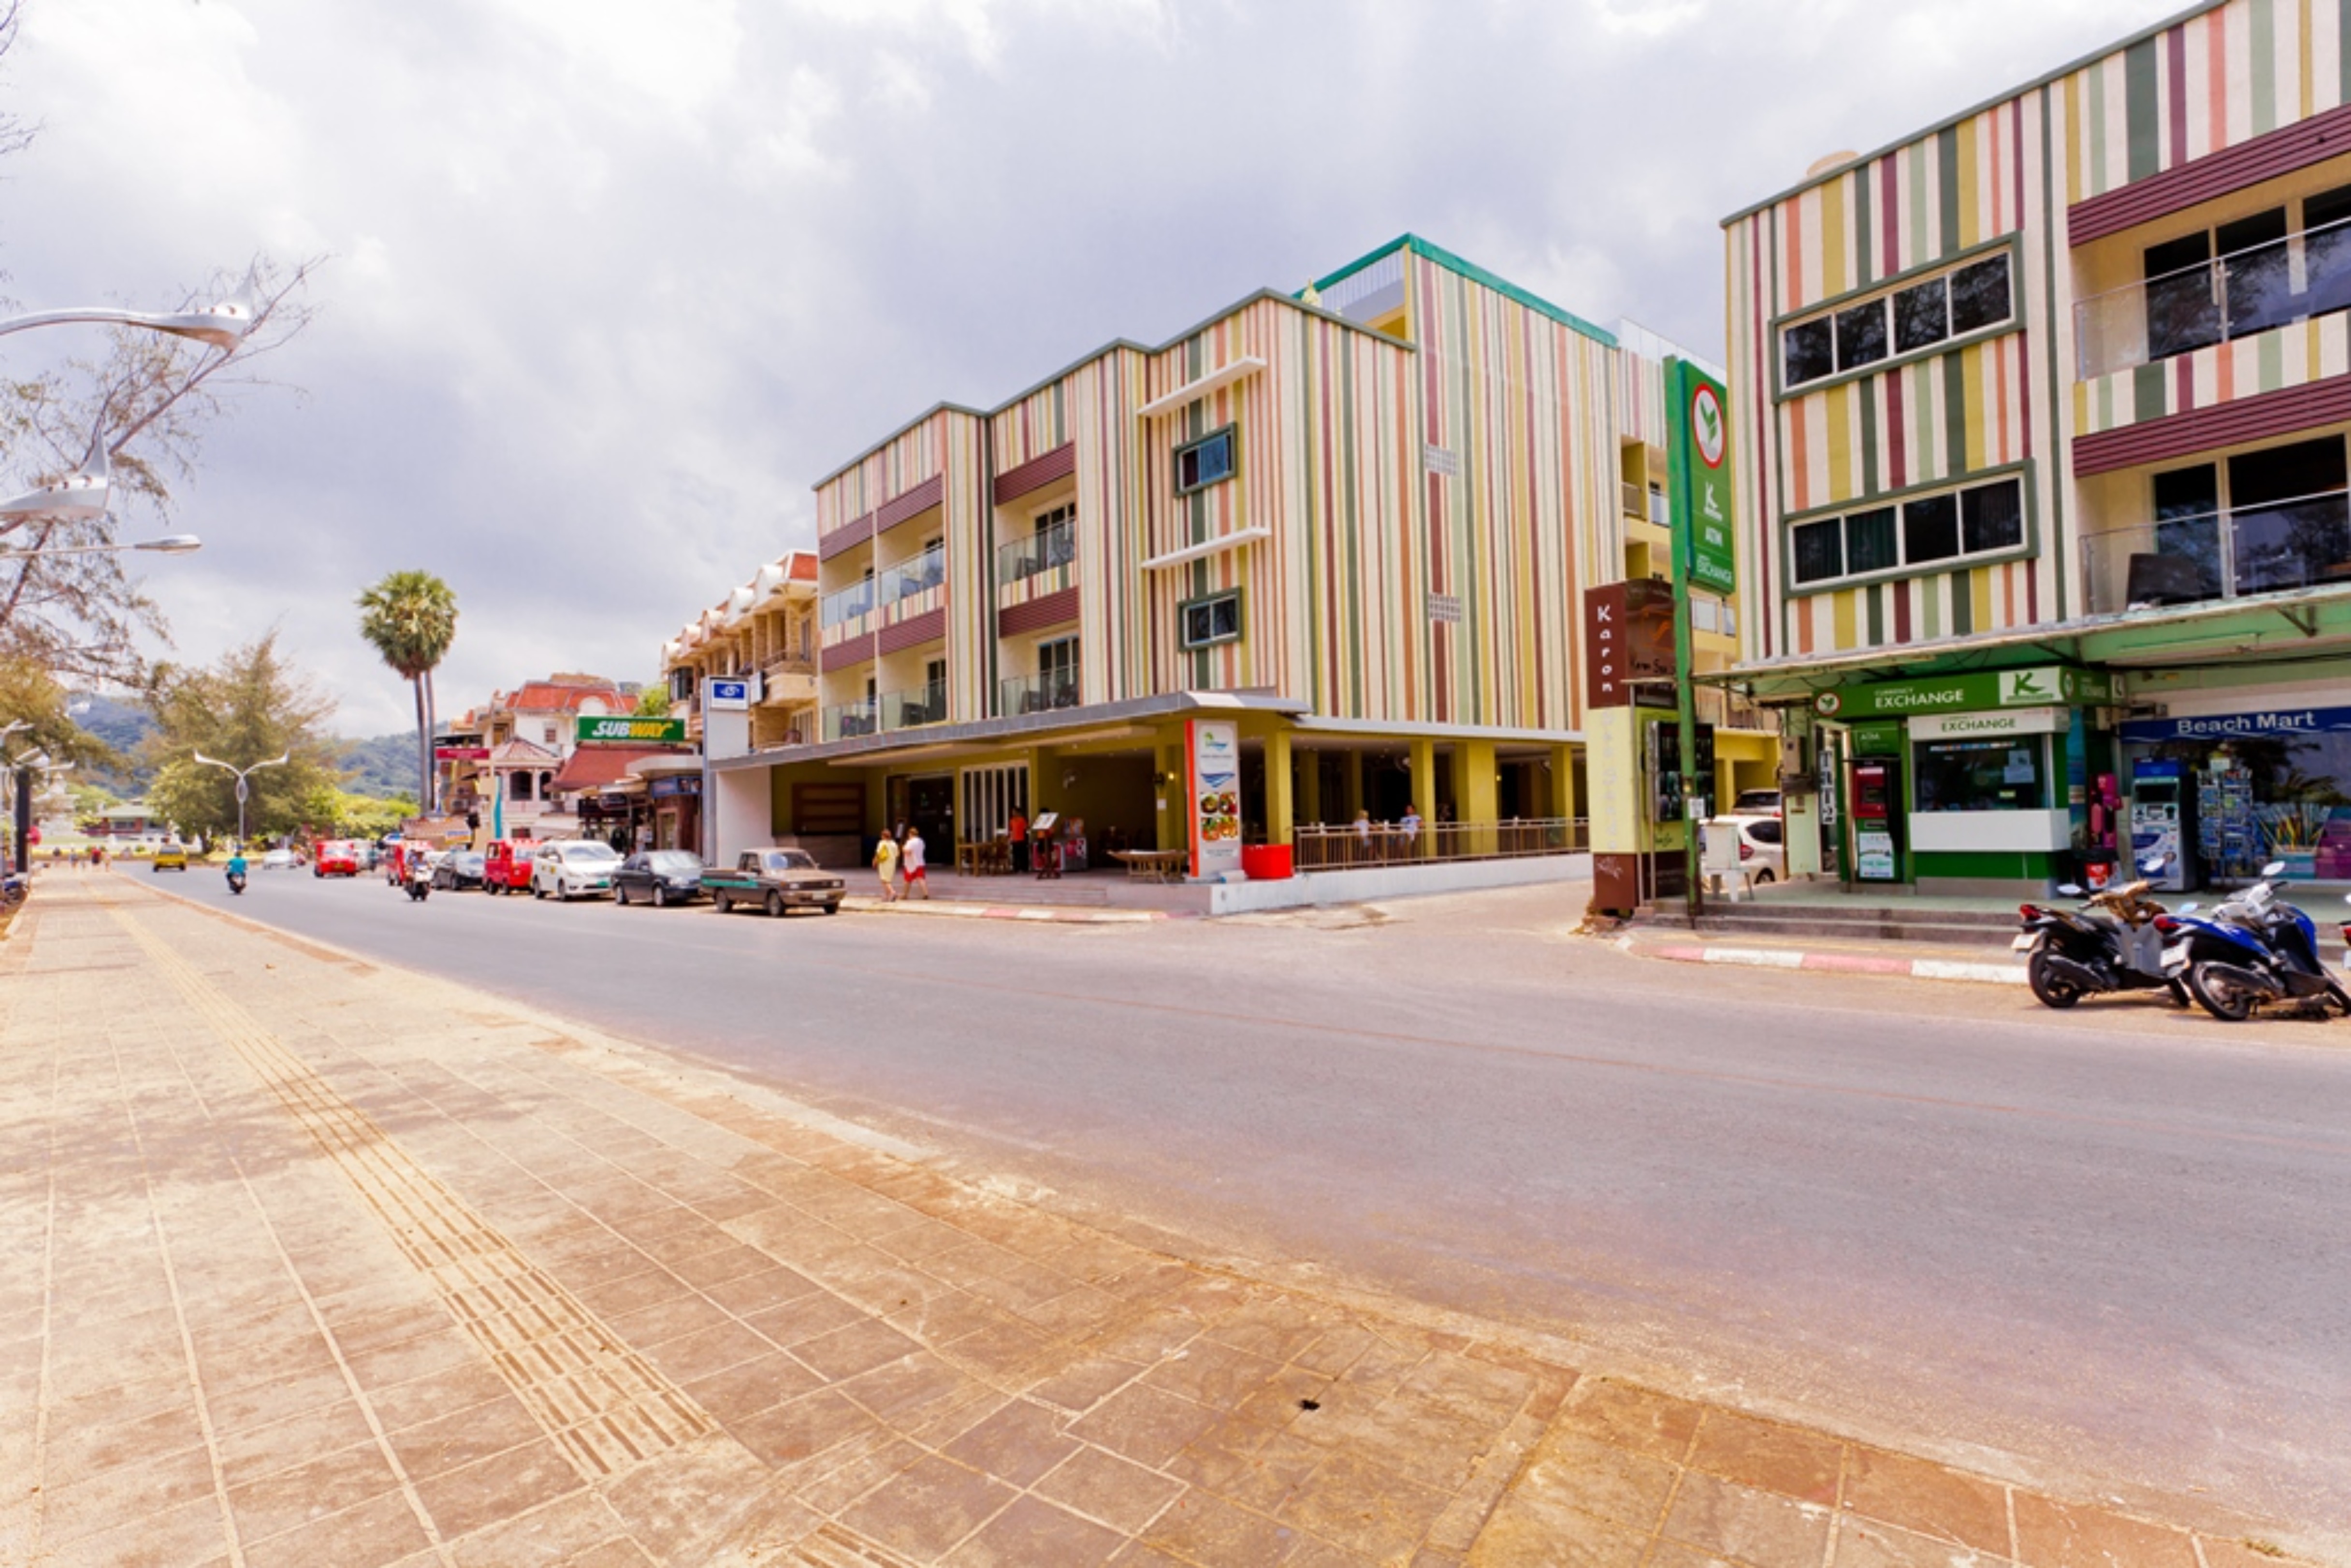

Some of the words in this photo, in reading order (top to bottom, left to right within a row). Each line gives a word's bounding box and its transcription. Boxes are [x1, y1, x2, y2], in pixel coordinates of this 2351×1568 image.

[1597, 604, 1613, 692] Karon
[1875, 689, 1964, 709] EXCHANGE
[592, 720, 673, 737] SUBWAY
[1942, 718, 2016, 733] EXCHANGE
[2177, 716, 2251, 734] Beach
[2256, 711, 2316, 729] Mart
